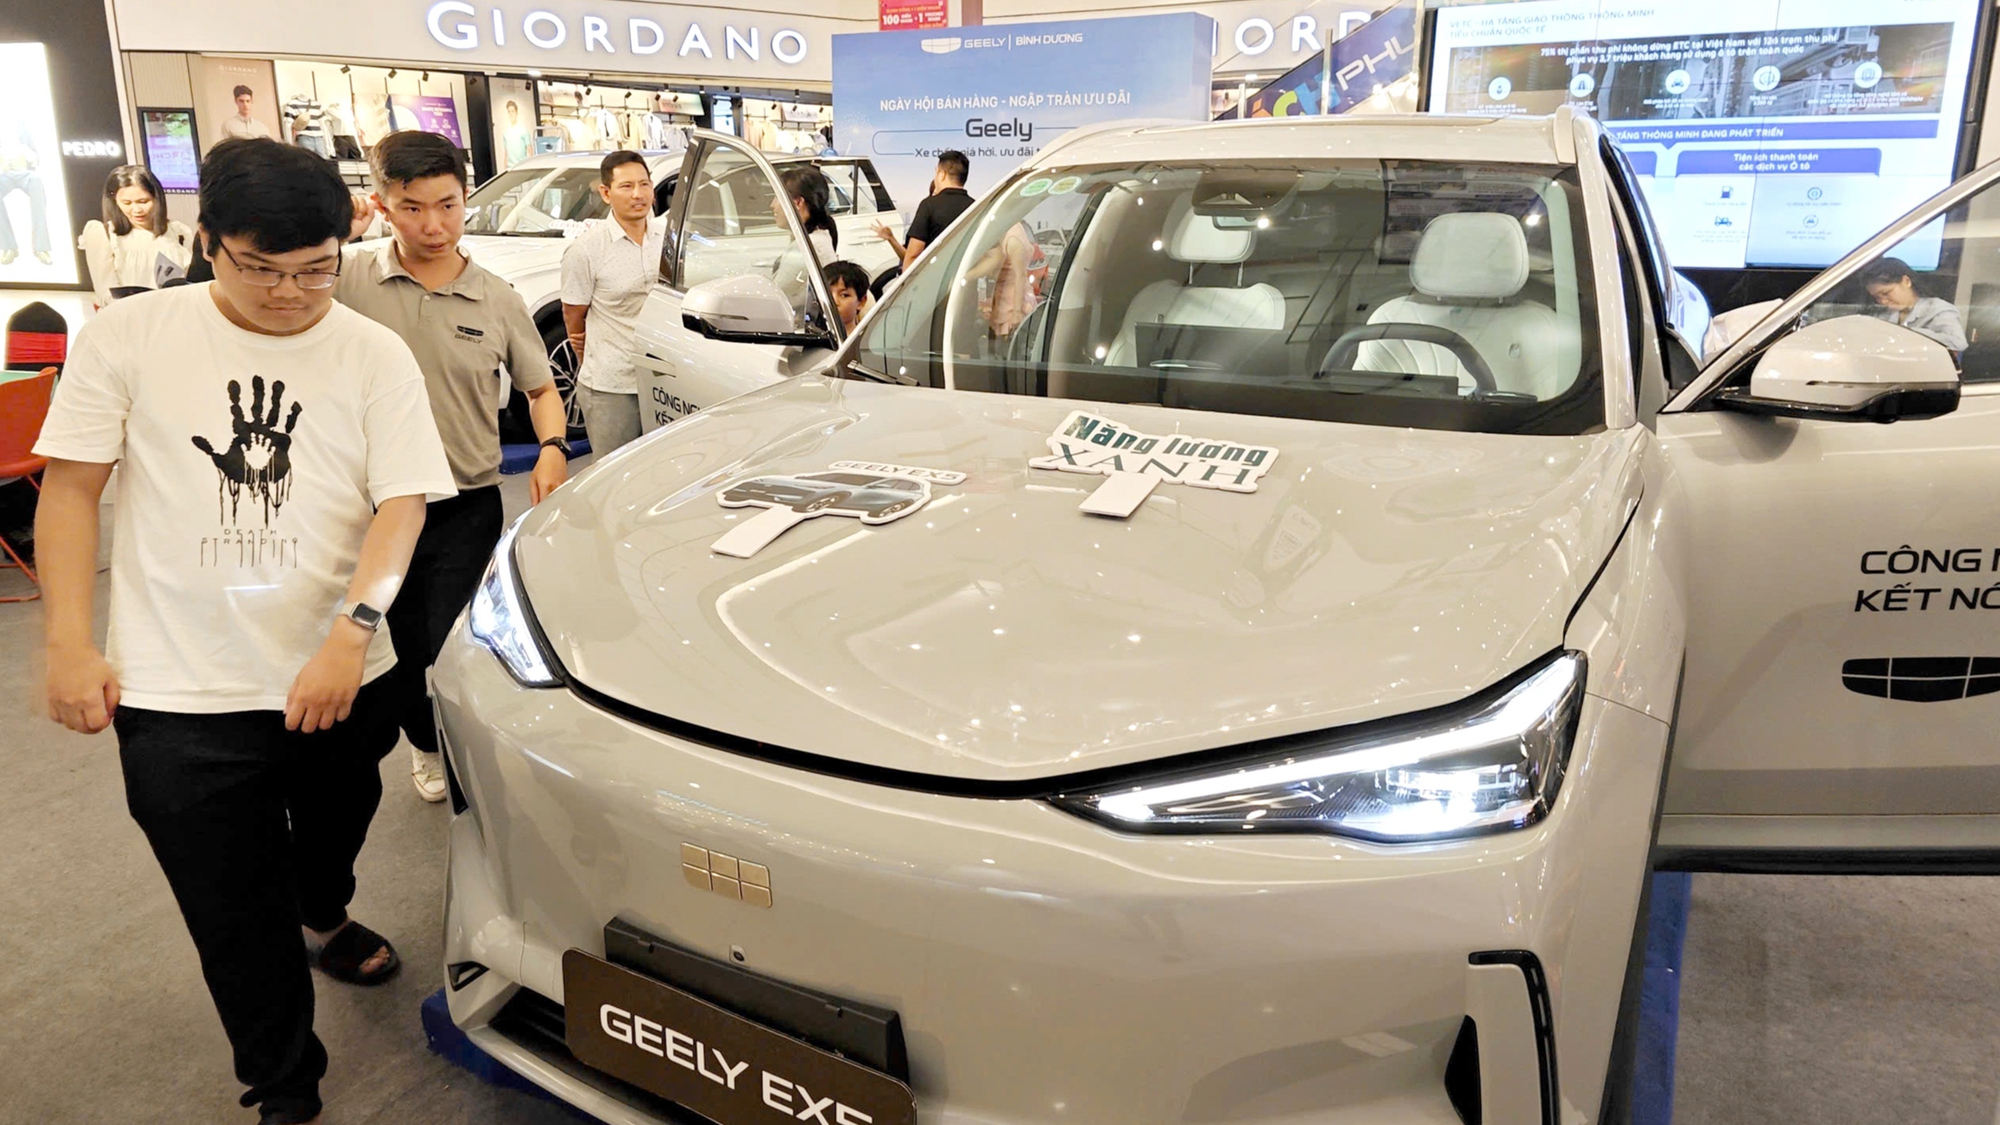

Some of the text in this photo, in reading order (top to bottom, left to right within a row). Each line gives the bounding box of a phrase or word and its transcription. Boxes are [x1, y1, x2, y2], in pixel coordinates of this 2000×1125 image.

[1524, 15, 1548, 24] GIAO
[1551, 12, 1585, 22] THÔNG
[1588, 9, 1624, 20] THÔNG
[1627, 8, 1655, 18] MINH
[426, 0, 808, 64] GIORDANO
[964, 32, 1083, 49] GEELY BÌNH DƯƠNG
[1592, 45, 1606, 54] thu
[1608, 43, 1621, 55] phí
[1622, 42, 1648, 54] không
[1673, 40, 1690, 50] ETC
[1705, 38, 1724, 49] Việt
[1725, 38, 1745, 48] Nam
[1747, 35, 1761, 46] với
[1781, 35, 1803, 46] trạm
[1804, 33, 1820, 44] thu
[1821, 32, 1838, 44] phí
[1633, 51, 1659, 62] khách
[880, 95, 912, 112] NGÀY
[913, 95, 934, 113] HỘI
[936, 93, 962, 110] BÁN
[963, 92, 998, 109] HÀNG
[1009, 91, 1043, 110] NGẬP
[1048, 90, 1082, 106] TRÀN
[1084, 92, 1106, 106] ƯU
[1107, 88, 1131, 105] ĐÃI
[965, 117, 1033, 142] Geely
[1641, 128, 1673, 140] THÔNG
[1675, 128, 1699, 139] MINH
[1729, 127, 1754, 138] PHÁT
[61, 140, 121, 157] PEDRO
[914, 147, 930, 158] Xe
[1000, 147, 1014, 157] ưu
[1017, 146, 1034, 157] đãi
[1733, 151, 1819, 163] Tiện ích thanh toán
[1738, 161, 1754, 171] các
[1755, 161, 1775, 172] dịch
[1777, 163, 1789, 172] vụ
[1800, 160, 1811, 171] tô
[454, 333, 483, 345] GEELY
[652, 386, 682, 413] CÔNG
[1062, 414, 1269, 467] Năng lượng
[833, 461, 962, 481] GEELY EX5
[1044, 441, 1251, 485] XANH
[1860, 544, 1982, 575] CÔNG
[1854, 581, 1942, 612] KẾT
[599, 1003, 749, 1090] GEELY
